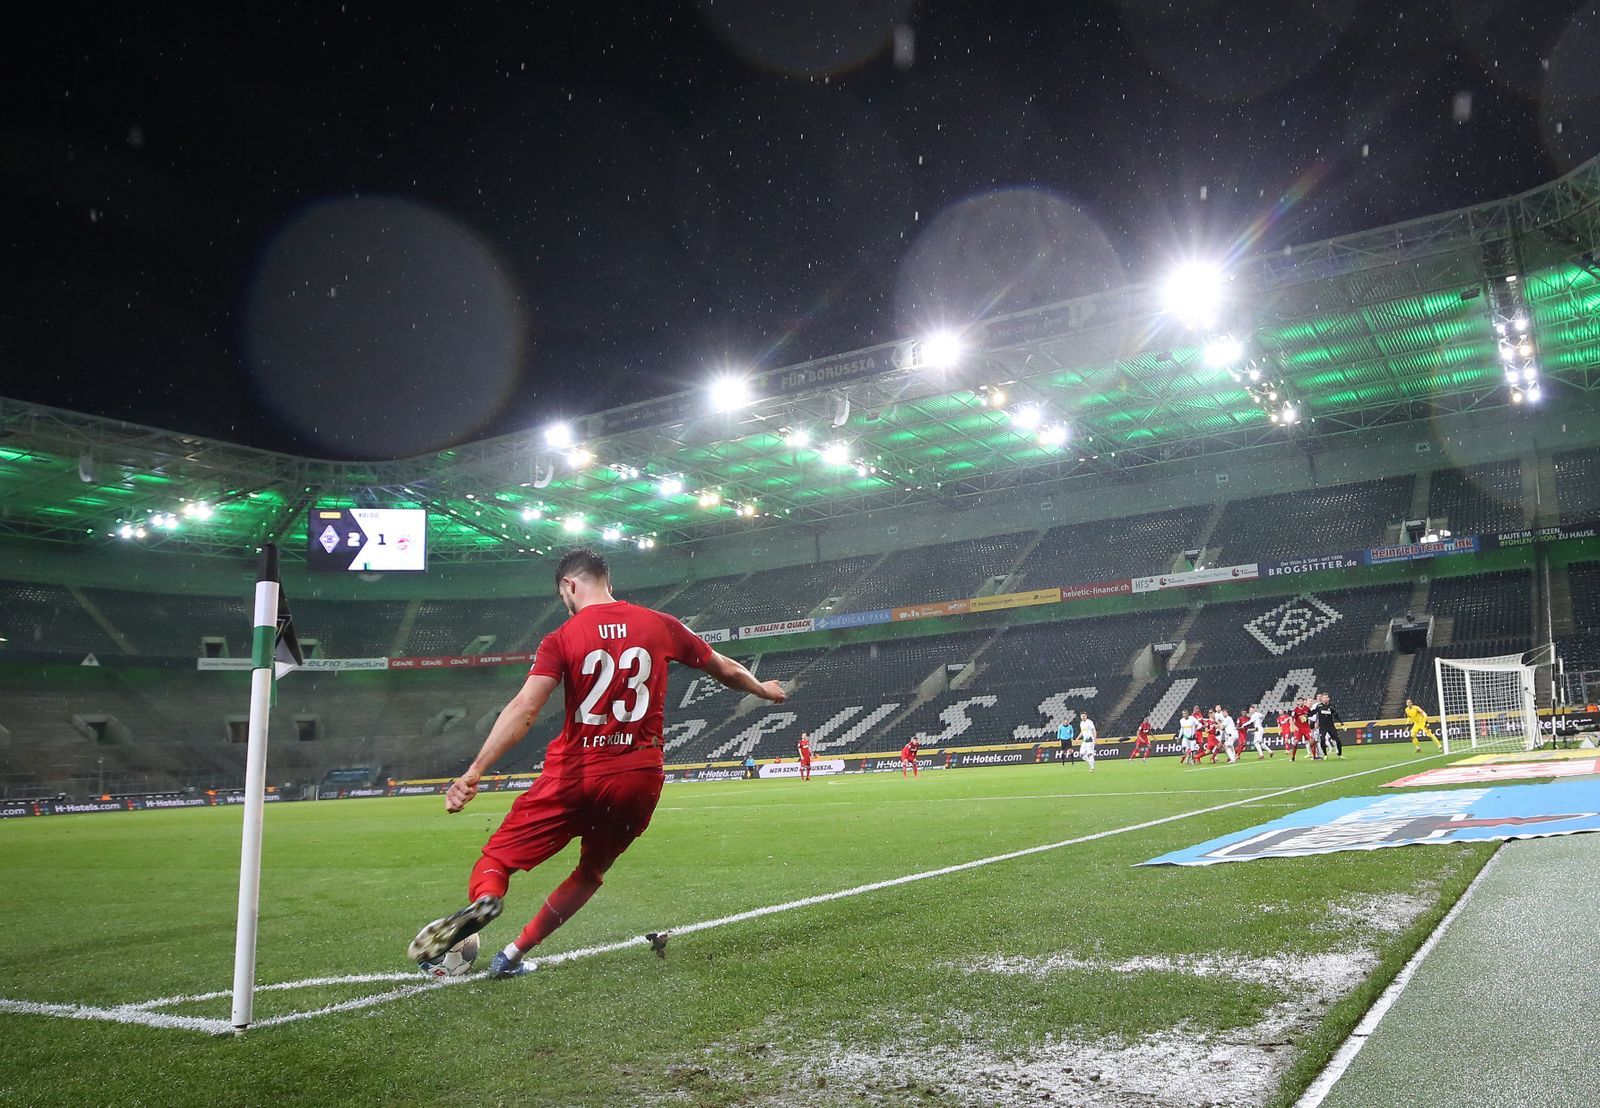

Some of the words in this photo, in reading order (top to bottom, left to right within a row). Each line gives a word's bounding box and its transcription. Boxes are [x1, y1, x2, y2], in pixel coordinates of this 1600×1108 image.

[808, 357, 875, 382] BORUSSIA
[347, 532, 360, 547] 2
[378, 534, 386, 545] 1
[1499, 532, 1520, 541] RAUTE
[1534, 527, 1562, 536] ERZEN,
[1570, 529, 1597, 538] HAUSE.
[1371, 543, 1419, 559] Heinrich
[1421, 538, 1473, 553] Temmink
[1268, 559, 1357, 576] BROGSITTER.de
[1063, 583, 1130, 598] helvetic-finance.ch
[1135, 579, 1150, 589] HFS
[831, 615, 865, 625] MEDICAL
[870, 613, 890, 621] PARK
[598, 623, 628, 639] UTH
[754, 622, 780, 633] NELLEN
[780, 621, 785, 630] &
[787, 620, 811, 629] QUACK
[704, 633, 722, 642] OHG
[575, 646, 652, 726] 23
[593, 735, 606, 747] FC
[607, 732, 633, 746] KÖLN
[962, 754, 1023, 764] H-Hotels.com
[698, 769, 746, 779] H-Hotels.com
[55, 802, 121, 813] H-Hotels.com
[146, 798, 205, 807] H-Hotels.com
